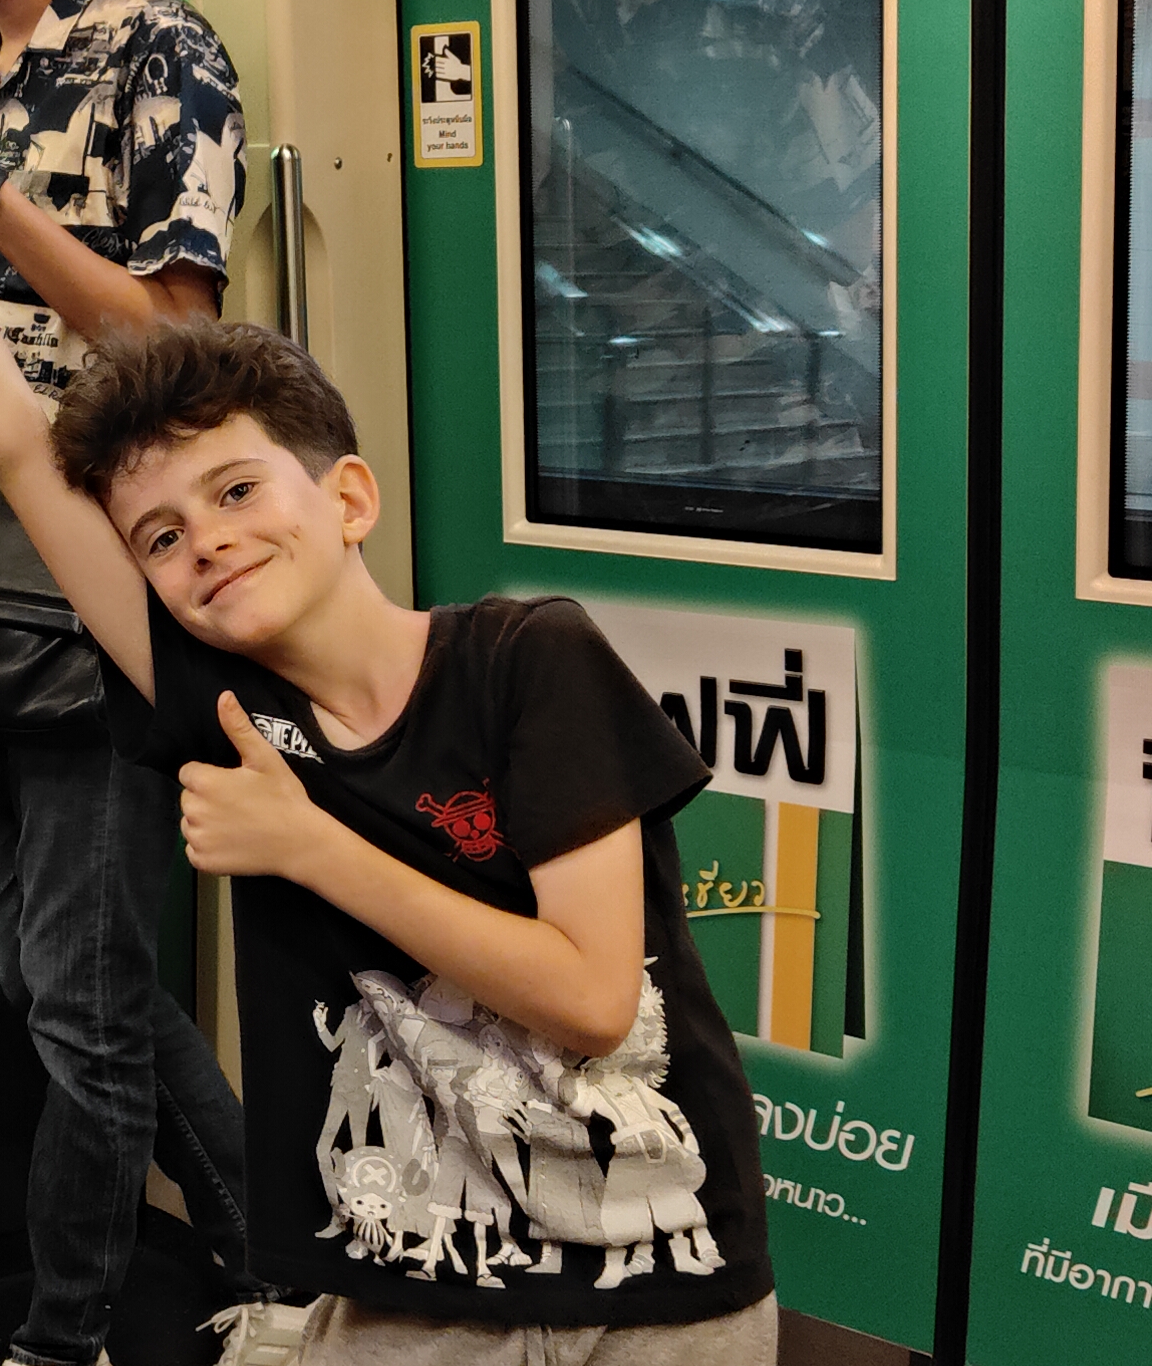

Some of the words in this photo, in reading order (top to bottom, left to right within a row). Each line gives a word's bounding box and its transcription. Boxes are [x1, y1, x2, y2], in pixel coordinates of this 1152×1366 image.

[439, 129, 457, 138] Mind
[427, 143, 444, 152] your
[445, 140, 469, 150] hands
